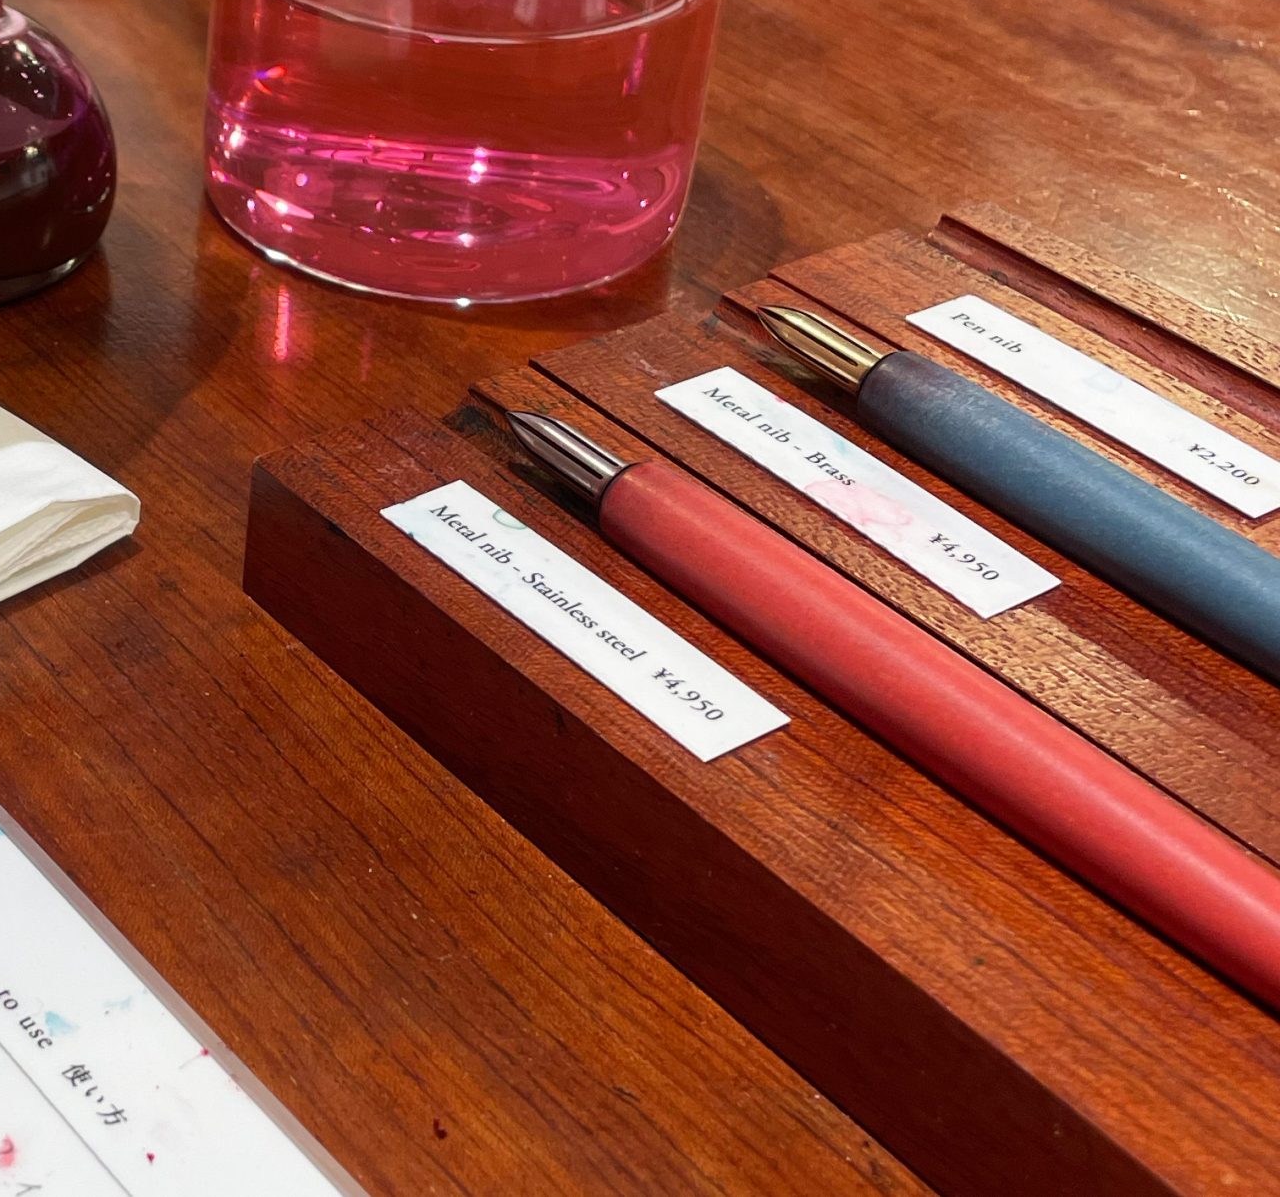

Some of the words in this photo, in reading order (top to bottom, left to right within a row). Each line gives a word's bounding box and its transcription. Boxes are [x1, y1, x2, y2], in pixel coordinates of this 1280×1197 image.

[702, 387, 761, 423] Metal
[757, 422, 791, 444] nib
[804, 451, 856, 487] Brass
[928, 532, 1000, 582] ¥4,950
[950, 312, 987, 335] Pen
[988, 332, 1022, 354] nib
[1187, 442, 1261, 487] ¥2,200
[429, 504, 488, 543] Metal
[478, 541, 512, 565] nib
[521, 570, 599, 630] Stainless
[596, 626, 648, 662] steel
[650, 666, 725, 722] ¥4,950
[19, 1015, 54, 1050] use
[61, 1063, 128, 1126] 使い方
